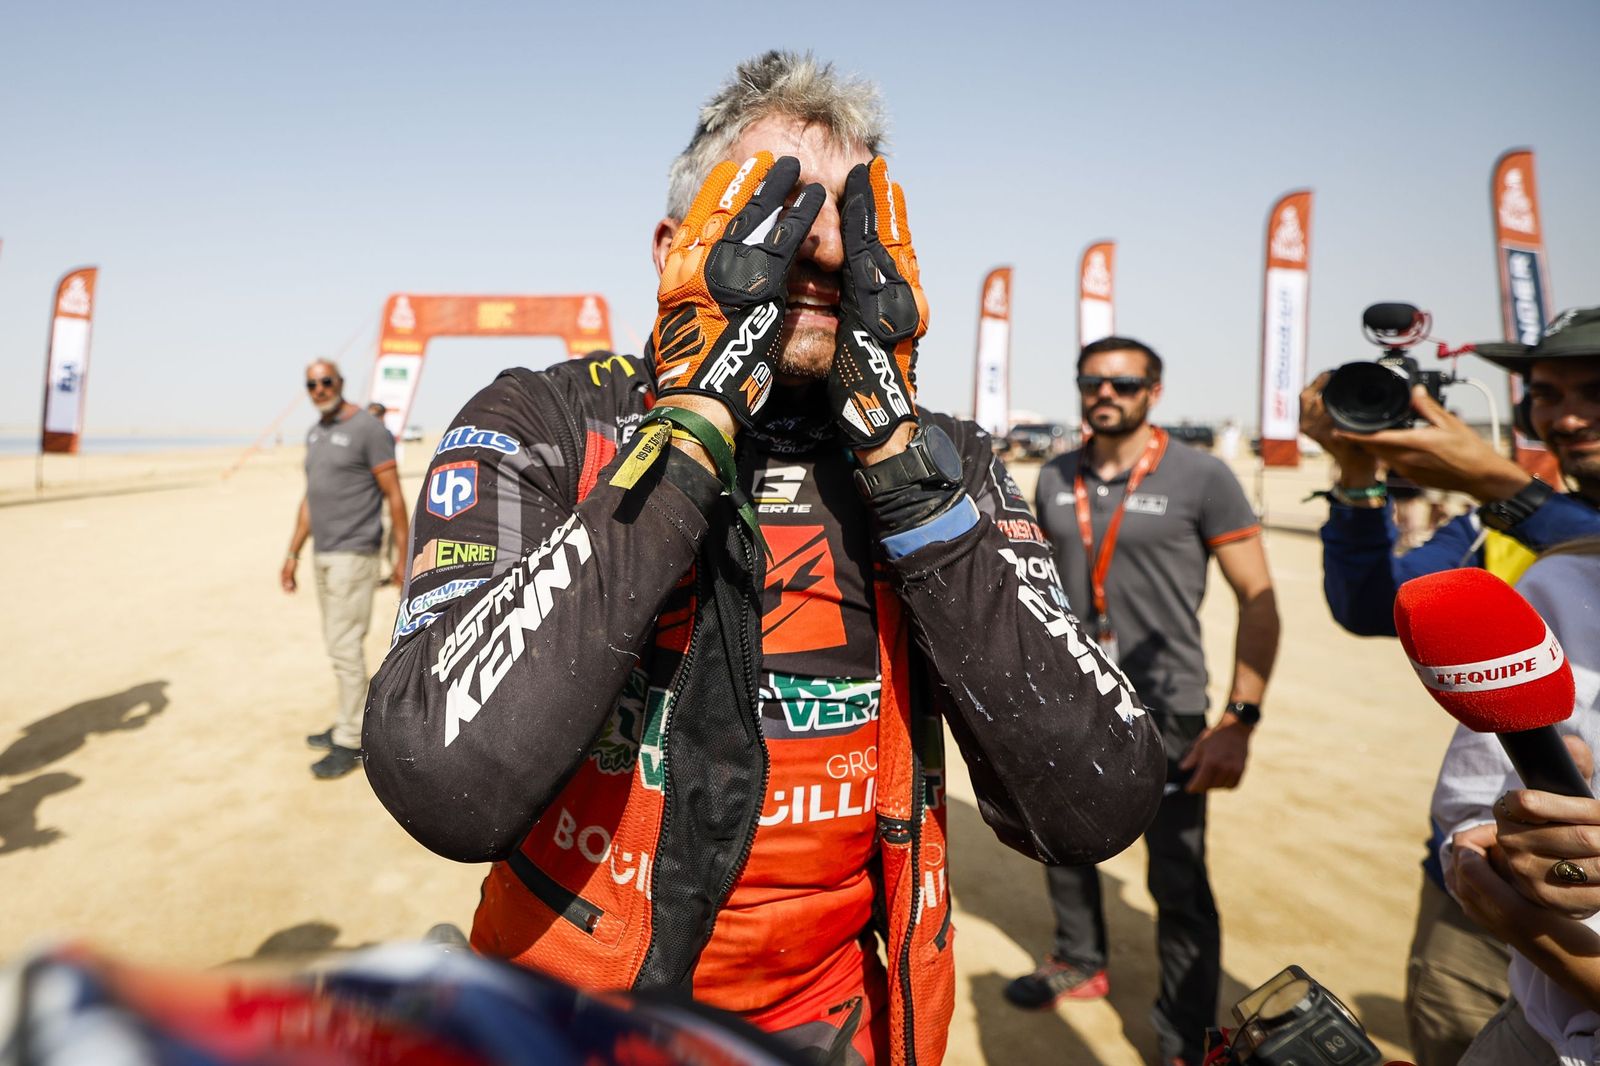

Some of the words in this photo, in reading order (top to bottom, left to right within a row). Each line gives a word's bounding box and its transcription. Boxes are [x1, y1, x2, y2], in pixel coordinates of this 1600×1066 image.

[700, 302, 778, 393] FIVE
[853, 330, 911, 418] FIVE
[444, 523, 592, 747] KENNY
